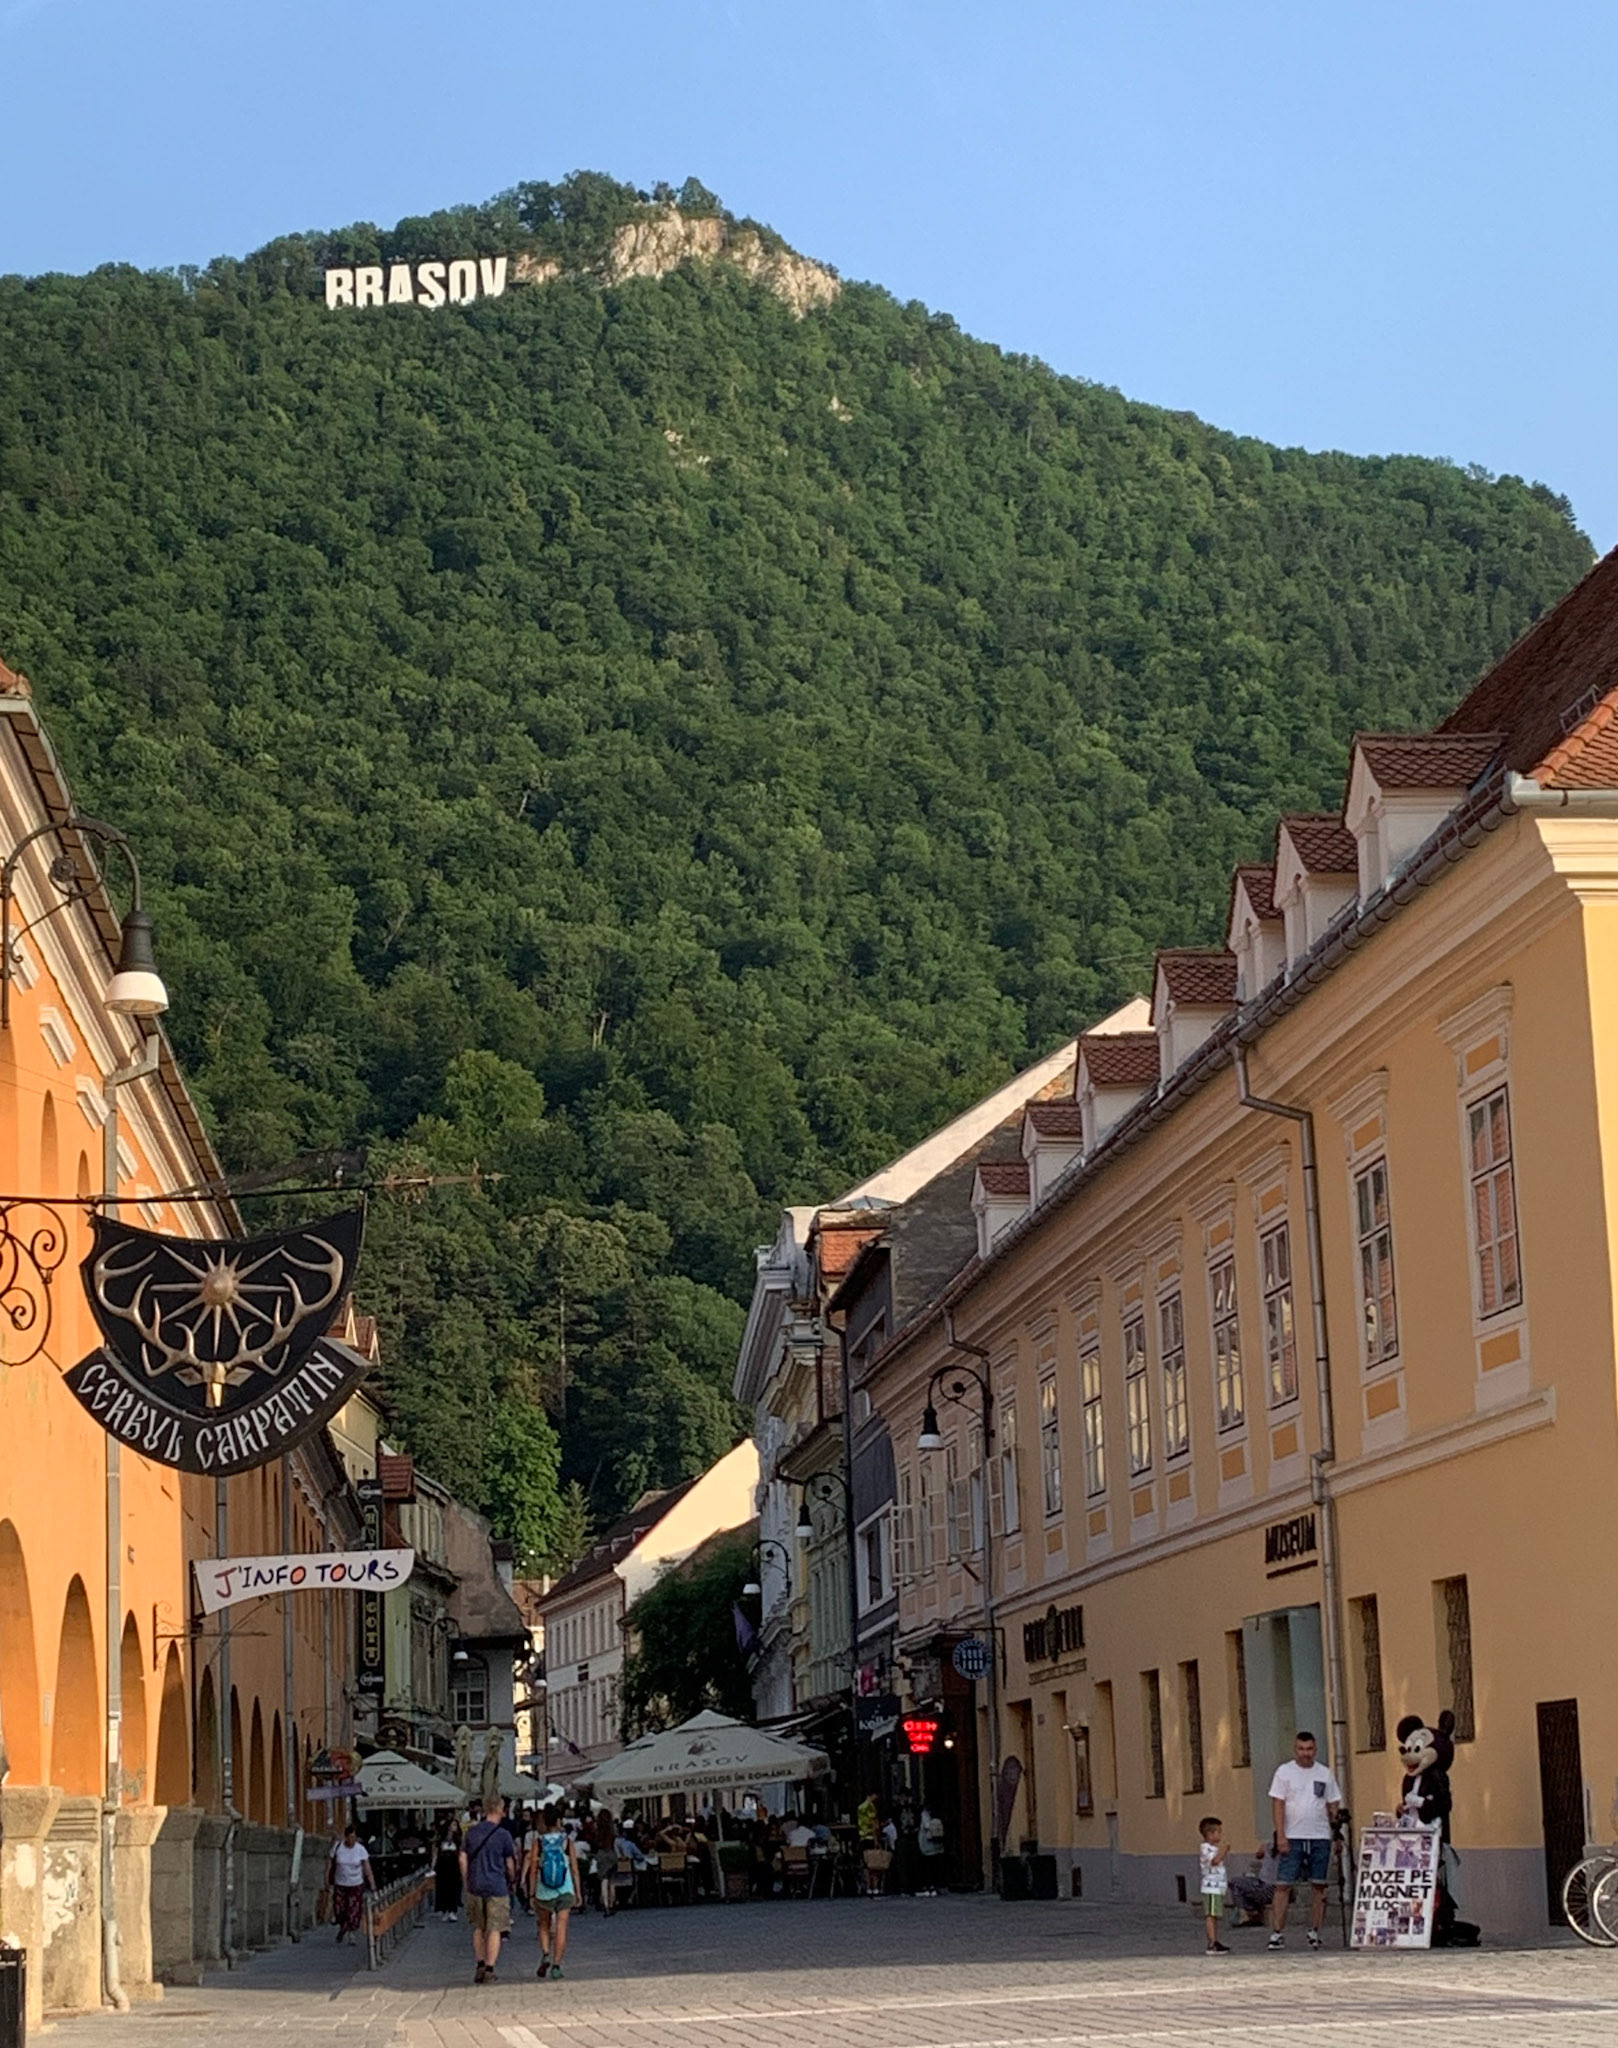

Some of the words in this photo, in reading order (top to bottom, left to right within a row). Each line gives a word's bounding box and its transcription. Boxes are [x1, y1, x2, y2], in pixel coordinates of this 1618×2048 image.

[77, 1363, 185, 1463] CERBUL
[195, 1350, 345, 1469] CARPATIN
[1265, 1512, 1316, 1564] MUSEUM
[214, 1564, 306, 1599] J'INFO
[315, 1559, 399, 1582] TOURS
[1360, 1870, 1405, 1883] POZE
[1410, 1869, 1433, 1883] PE
[1357, 1900, 1371, 1911] PE
[1374, 1900, 1399, 1911] LOC
[1358, 1885, 1432, 1899] MAGNET
